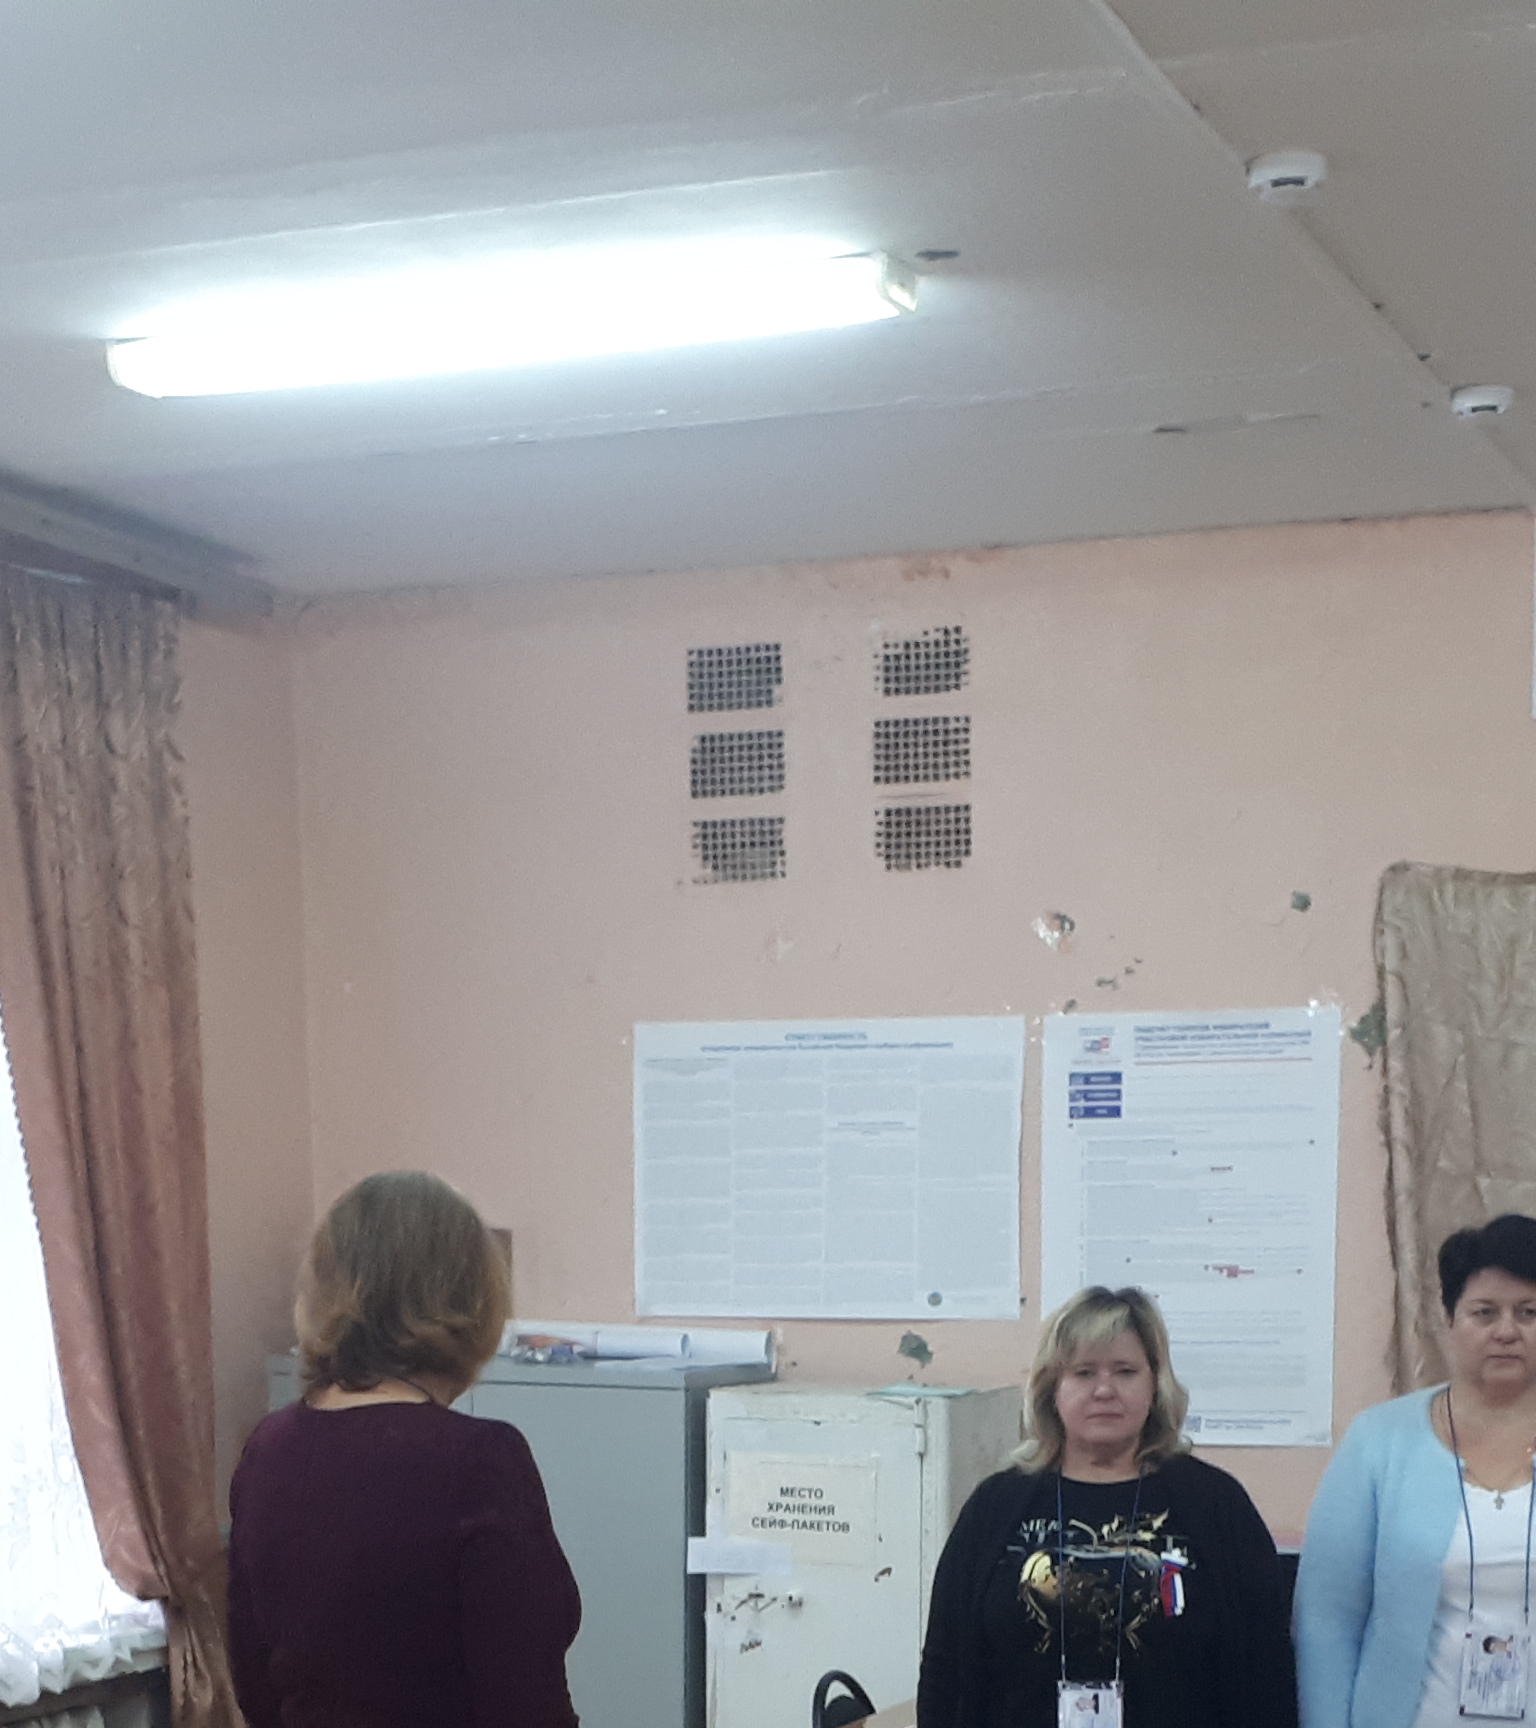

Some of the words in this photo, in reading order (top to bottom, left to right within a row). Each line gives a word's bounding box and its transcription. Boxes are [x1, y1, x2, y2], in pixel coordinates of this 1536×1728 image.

[779, 1486, 824, 1499] МЕСТО
[767, 1501, 835, 1516] ХРАНЕНИЯ
[751, 1517, 850, 1533] СЕЙФ-ПАКЕТОВ
